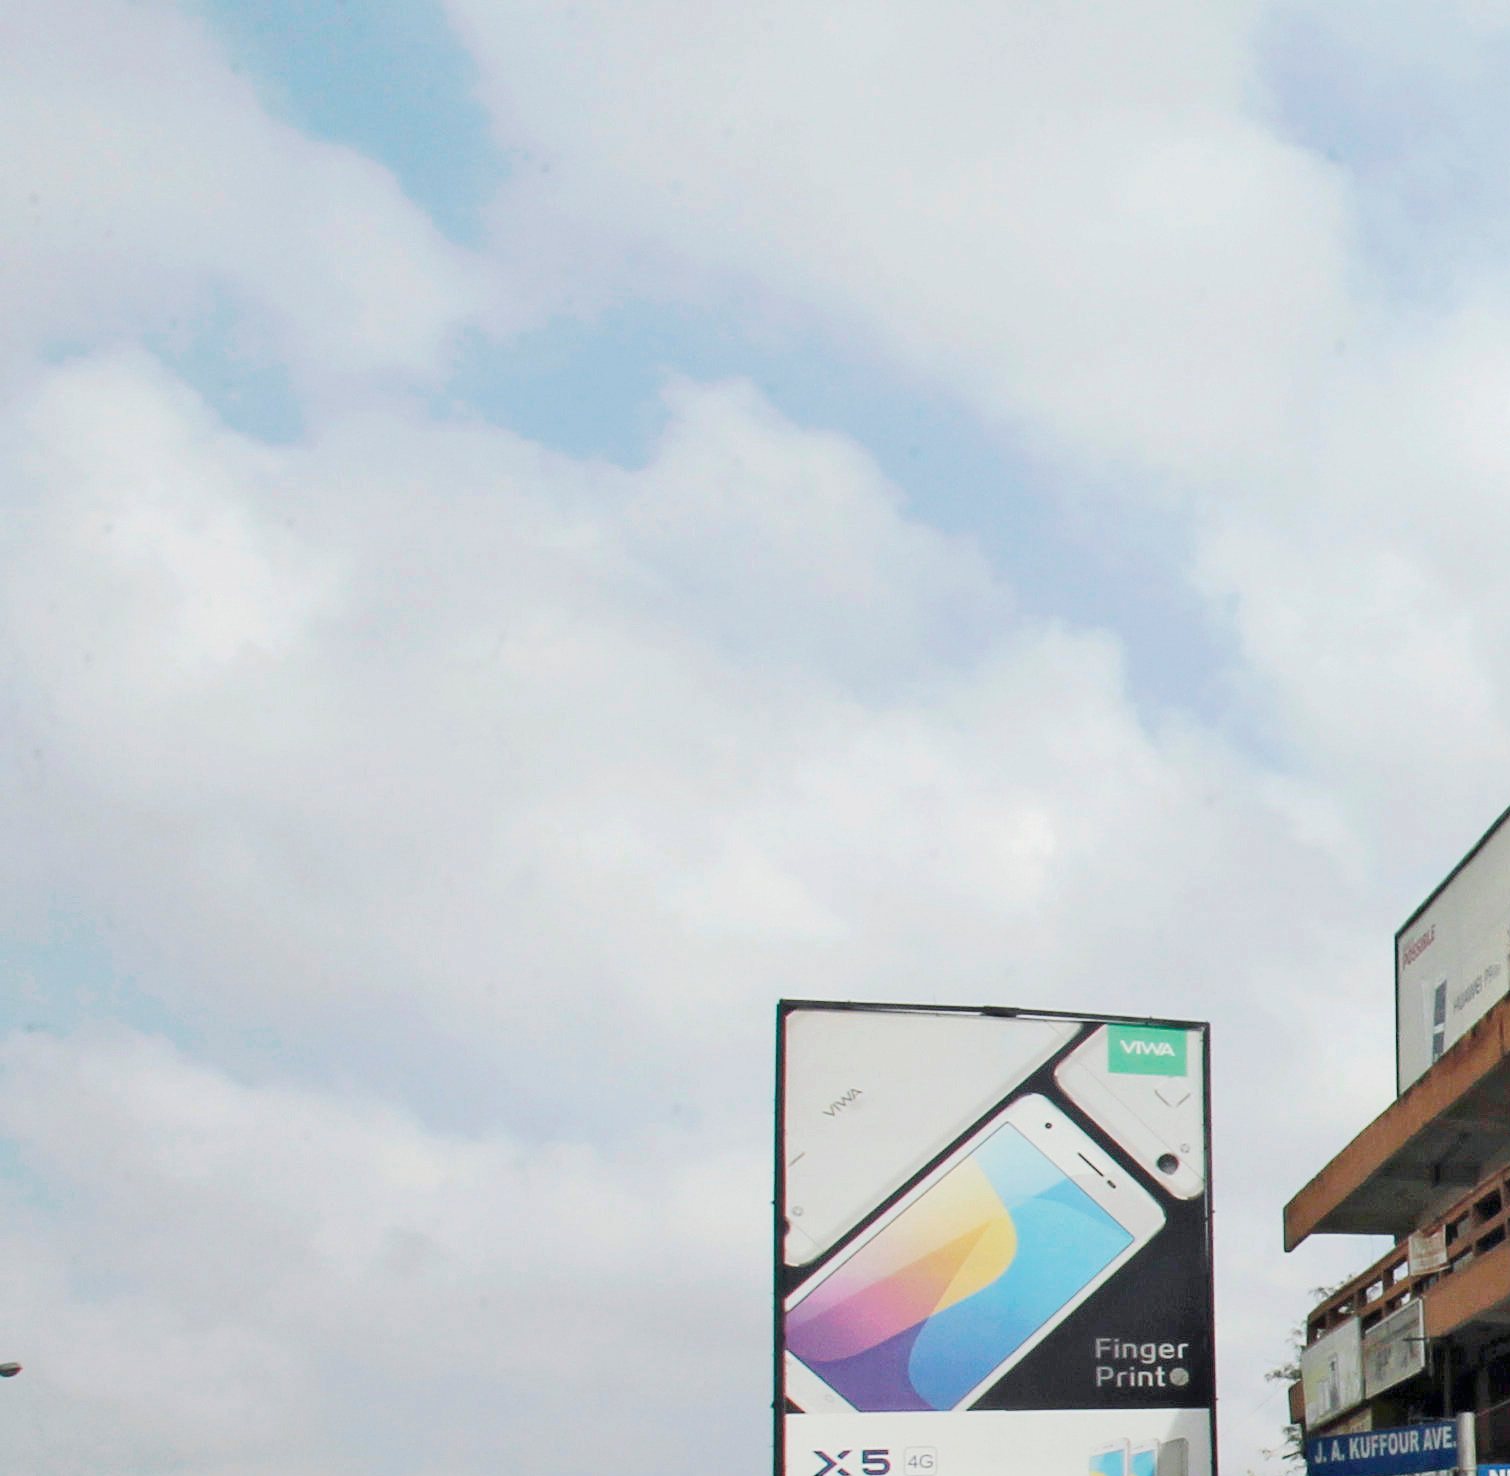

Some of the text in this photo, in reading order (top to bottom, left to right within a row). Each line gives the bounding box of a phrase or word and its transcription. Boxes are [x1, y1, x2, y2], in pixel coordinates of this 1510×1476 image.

[1119, 1039, 1176, 1057] VIWA
[822, 1087, 864, 1119] VIWA
[1094, 1337, 1190, 1366] Finger
[1095, 1364, 1166, 1389] Print
[1314, 1426, 1457, 1464] J. A. KUFFOUR AVE.
[906, 1453, 935, 1470] 4G
